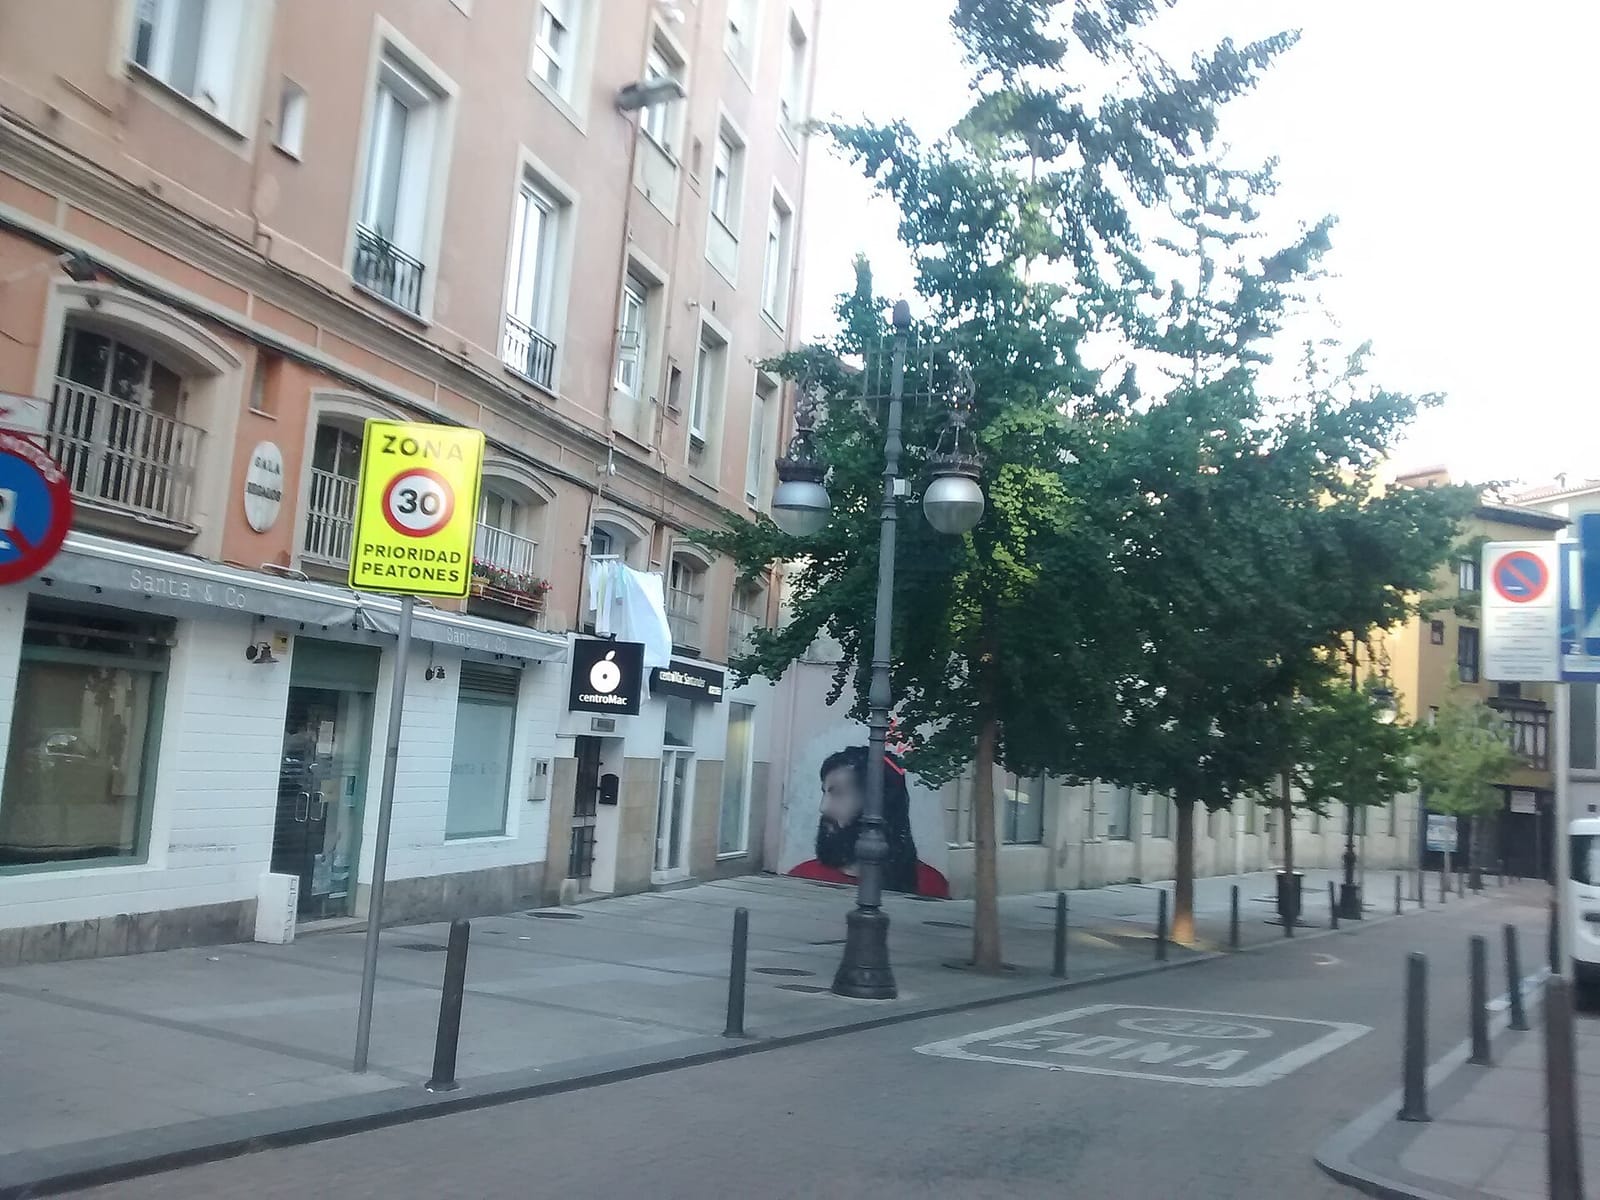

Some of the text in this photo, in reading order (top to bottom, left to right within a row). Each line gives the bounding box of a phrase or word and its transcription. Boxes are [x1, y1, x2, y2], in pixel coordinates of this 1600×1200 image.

[382, 434, 464, 462] ZONA
[397, 488, 441, 516] 30
[363, 543, 462, 564] PRIORIDAD
[361, 562, 459, 582] PEATONES
[129, 568, 191, 598] Santa
[225, 587, 247, 608] Co
[578, 694, 628, 706] centroMac
[988, 1030, 1249, 1070] ZONA
